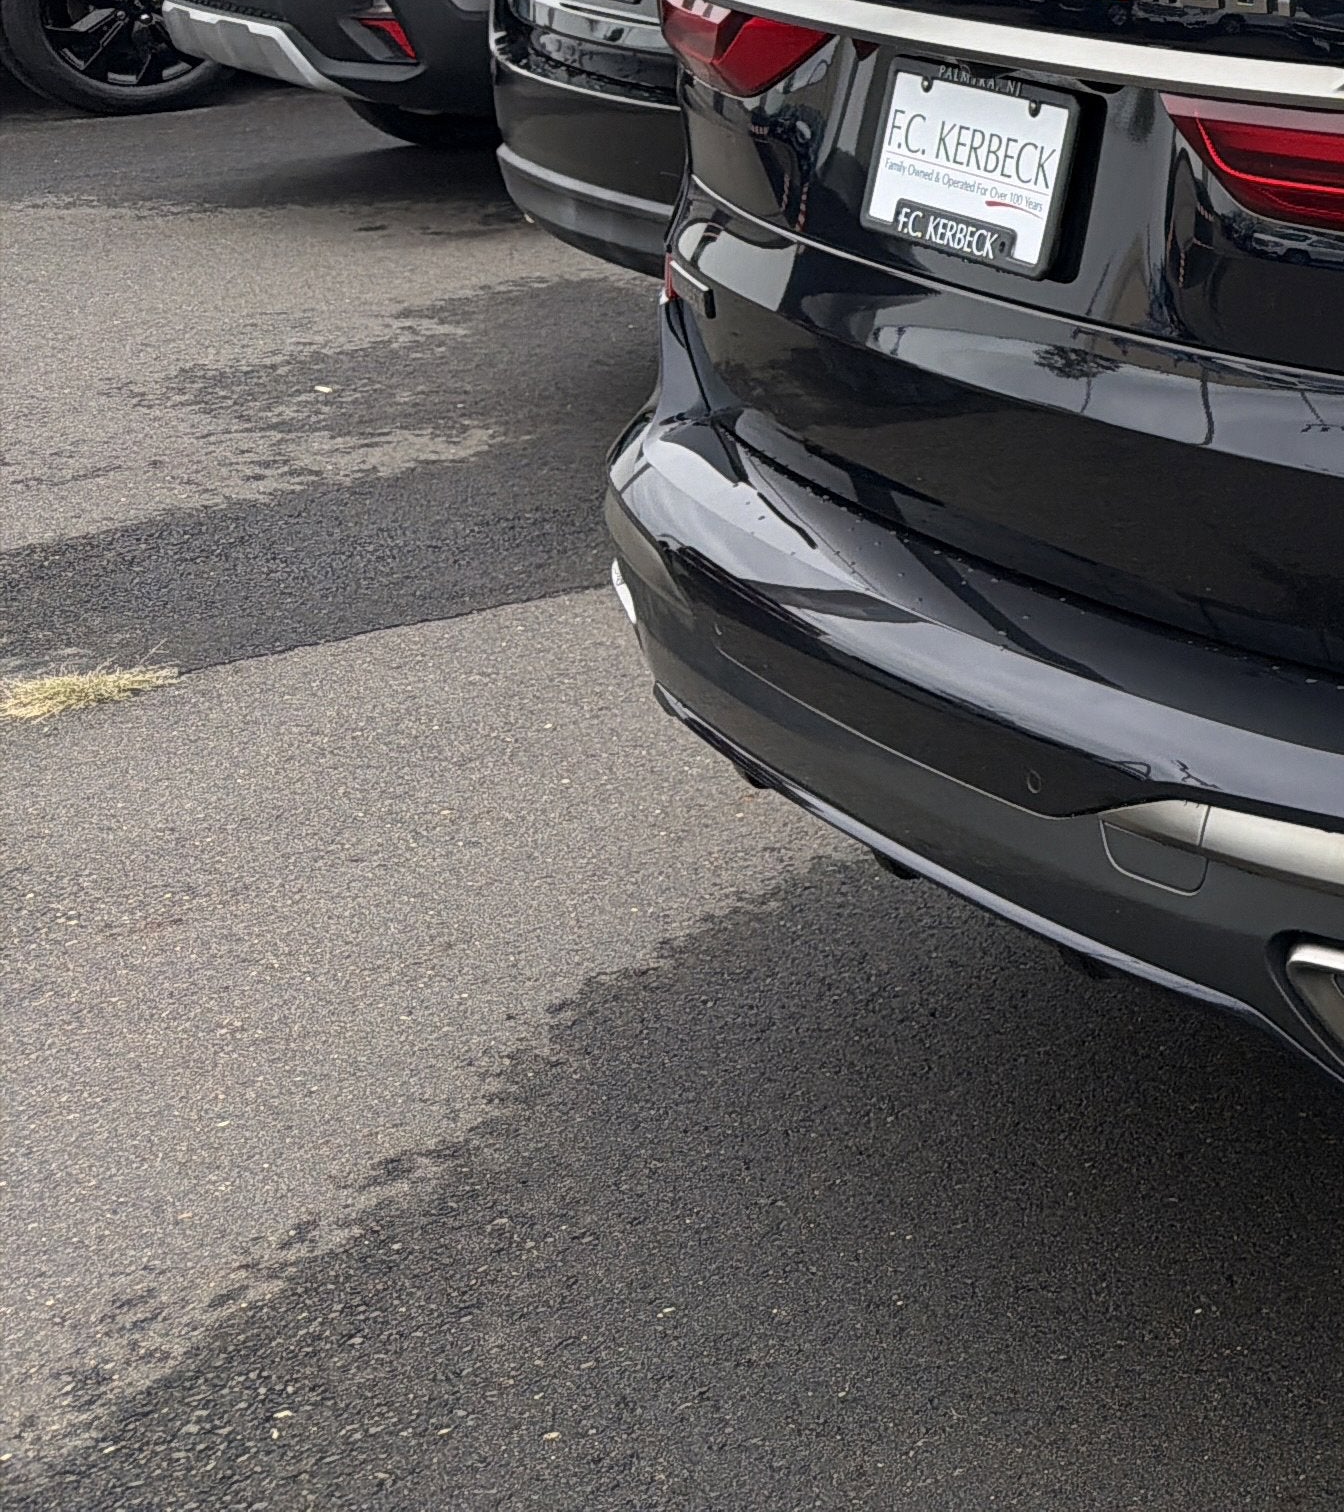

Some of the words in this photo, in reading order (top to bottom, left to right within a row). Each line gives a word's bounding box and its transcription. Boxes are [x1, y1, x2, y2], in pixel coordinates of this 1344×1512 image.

[887, 109, 926, 156] F.C.
[935, 120, 1057, 189] KERBECK
[884, 158, 907, 174] Family
[907, 164, 934, 182] Owned
[942, 173, 976, 193] Operated
[976, 183, 989, 196] For
[989, 186, 1008, 200] Over
[1009, 191, 1024, 206] 100
[1024, 194, 1044, 213] Years
[897, 207, 923, 238] F.C.
[925, 215, 999, 260] KERBECK
